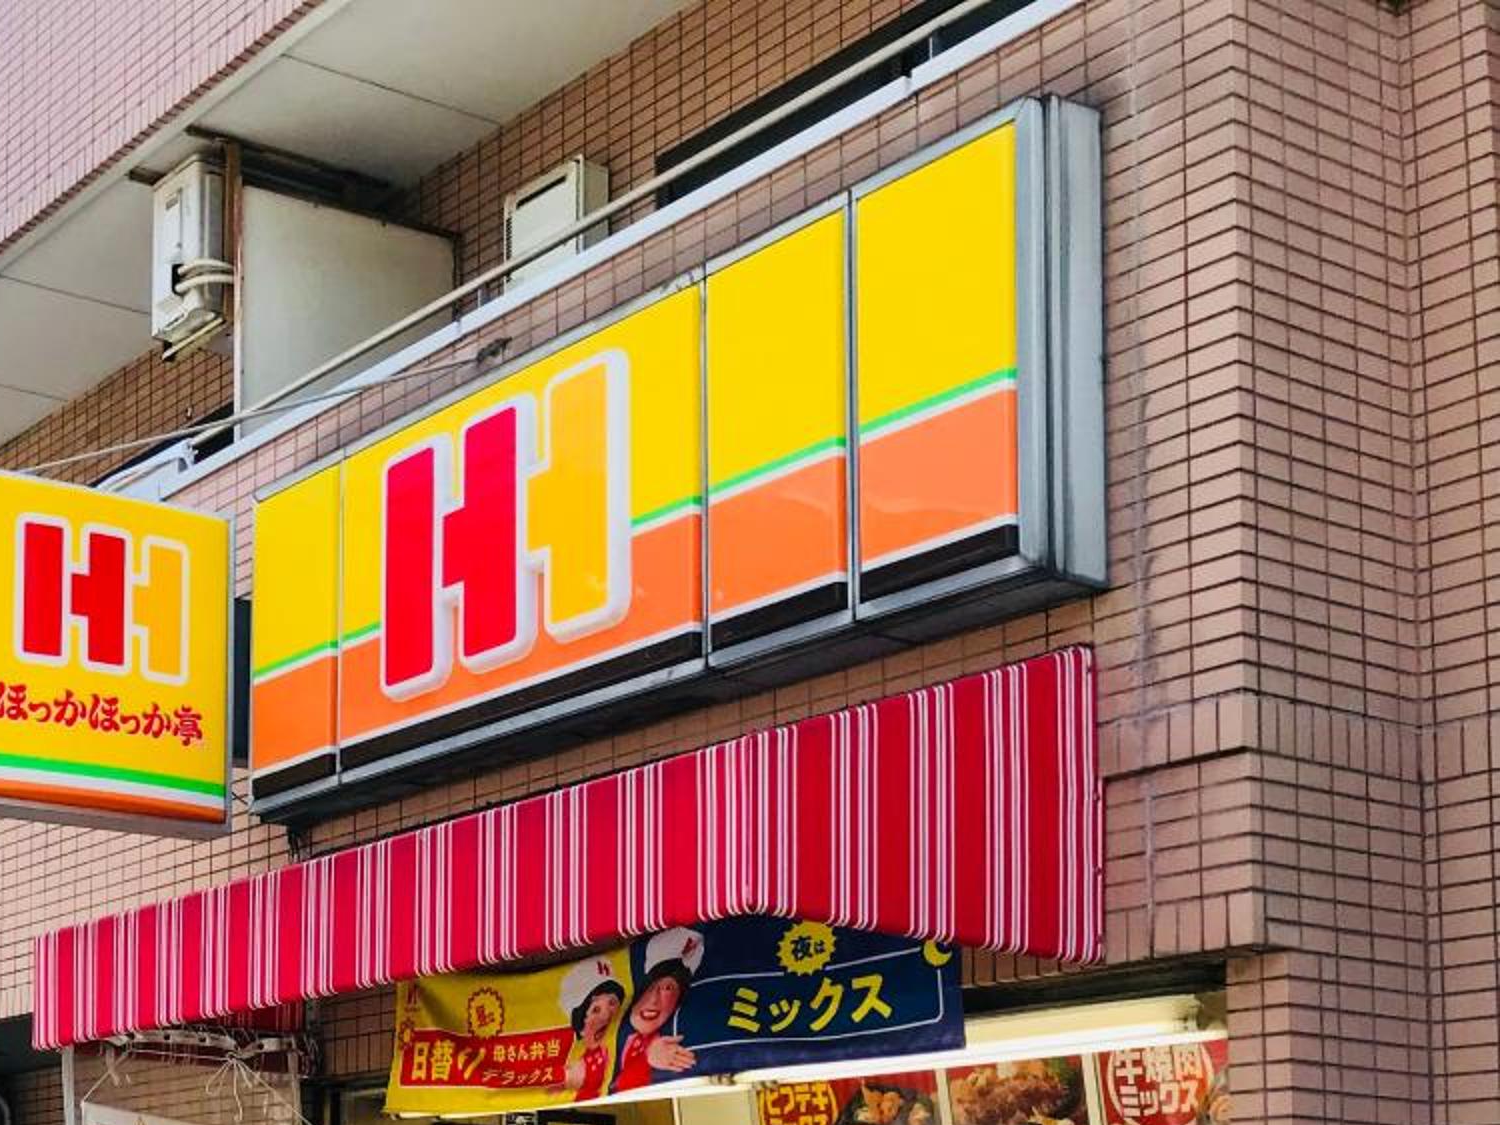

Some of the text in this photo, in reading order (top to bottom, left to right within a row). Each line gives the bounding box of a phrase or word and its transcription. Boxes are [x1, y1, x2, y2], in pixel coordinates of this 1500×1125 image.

[790, 938, 825, 962] 夜は
[727, 973, 893, 1034] ミックス
[482, 1067, 554, 1086] デラックス
[1114, 1045, 1204, 1085] 牛焼肉
[1120, 1080, 1201, 1117] ミックス
